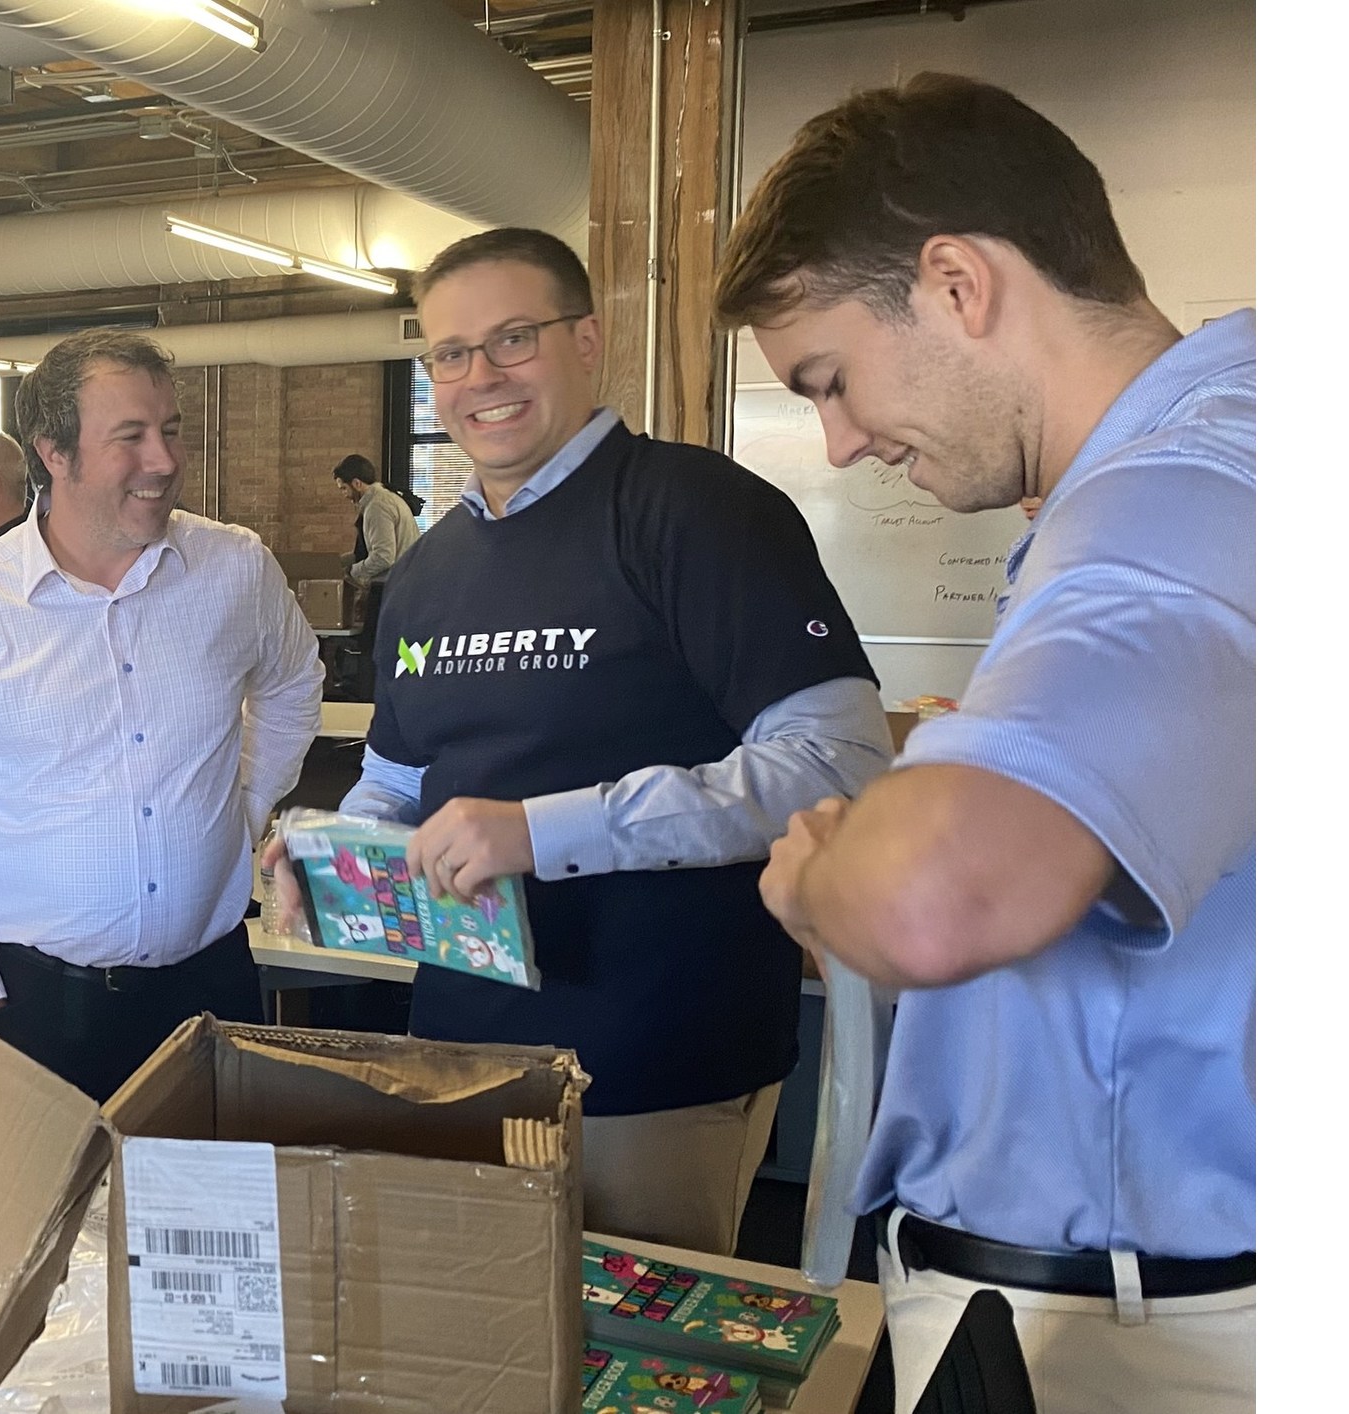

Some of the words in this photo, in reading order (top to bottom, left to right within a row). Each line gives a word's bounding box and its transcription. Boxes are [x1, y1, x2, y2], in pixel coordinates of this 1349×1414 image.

[939, 552, 991, 566] CONFIRMED
[437, 627, 598, 658] LIBERTY
[433, 656, 507, 675] ADVISOR
[518, 653, 590, 670] GROUP
